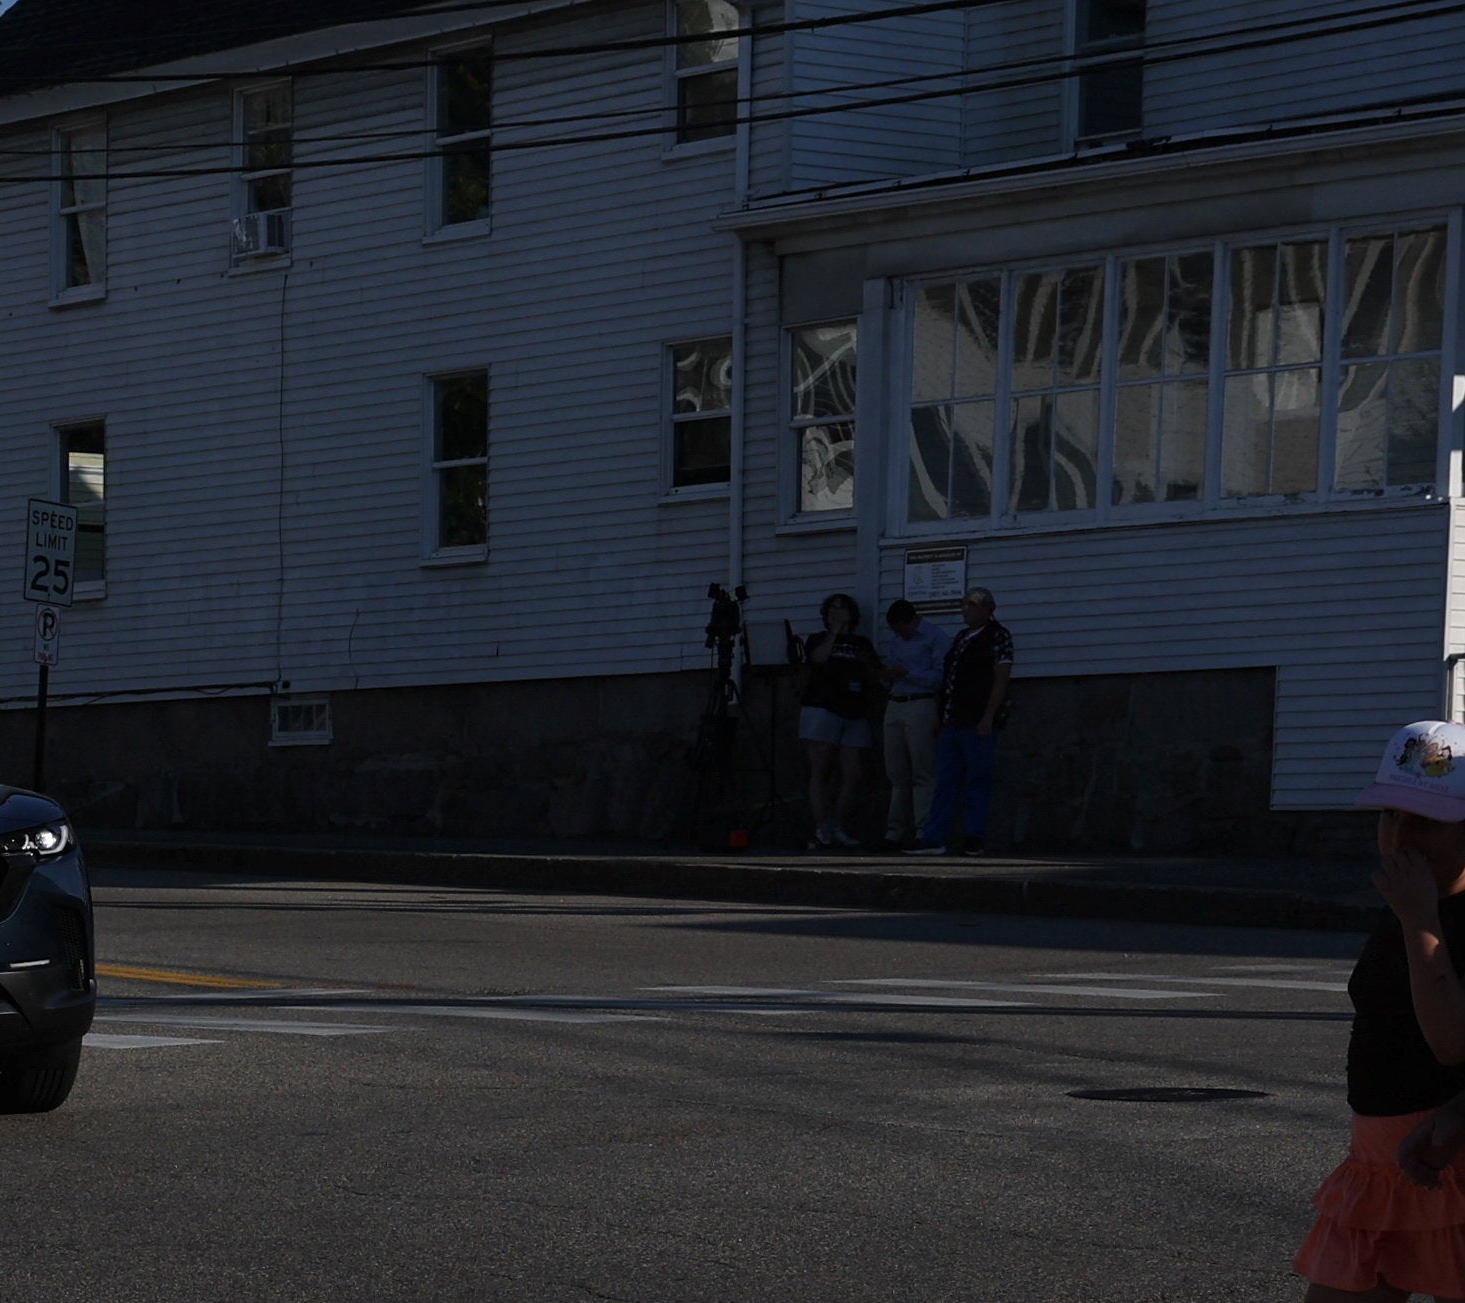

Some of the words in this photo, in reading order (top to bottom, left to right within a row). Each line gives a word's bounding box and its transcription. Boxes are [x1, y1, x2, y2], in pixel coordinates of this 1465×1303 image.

[31, 509, 74, 531] SPEED
[35, 532, 69, 551] LIMIT
[30, 555, 70, 595] 25
